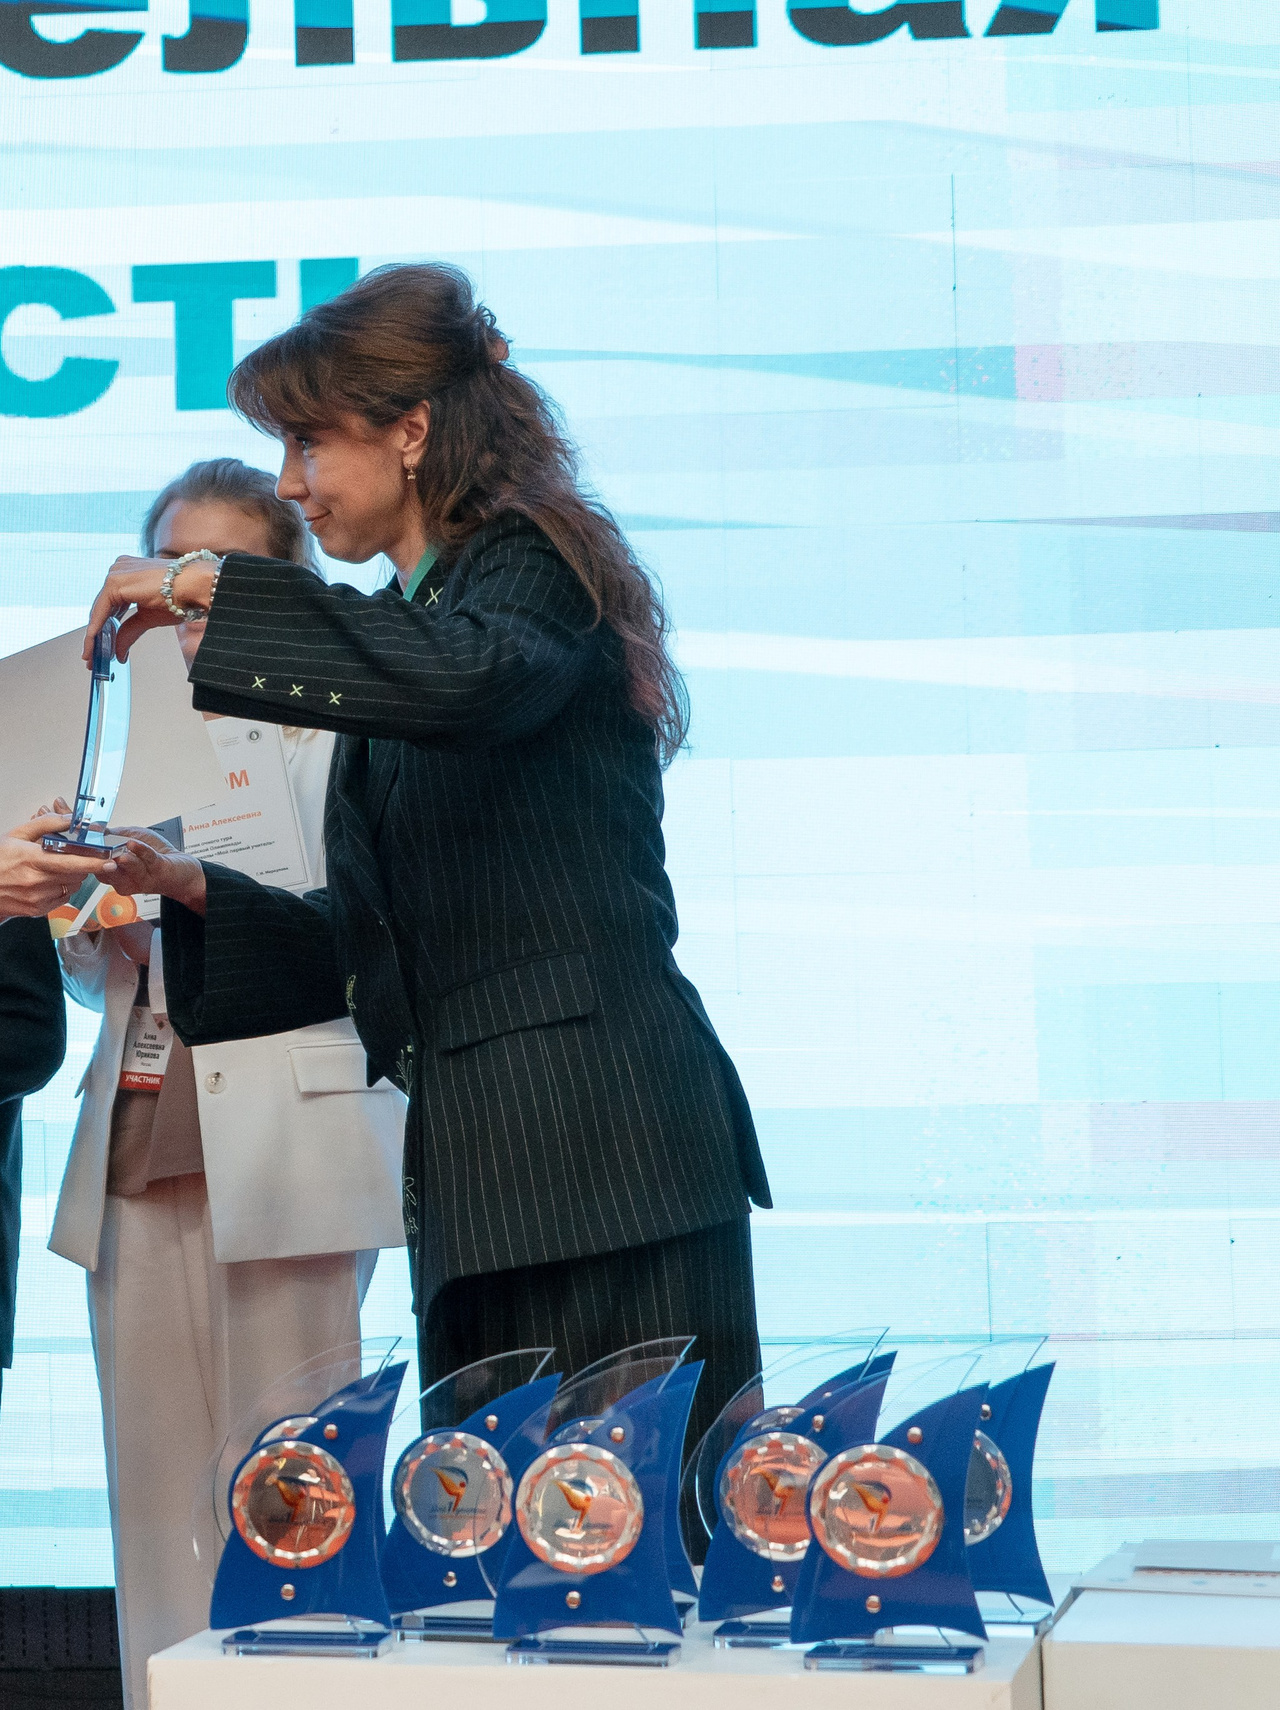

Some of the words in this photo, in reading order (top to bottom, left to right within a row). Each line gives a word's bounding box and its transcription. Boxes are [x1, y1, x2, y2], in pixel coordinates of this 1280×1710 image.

[188, 822, 210, 832] Анна
[211, 810, 262, 827] Алексеевна
[144, 1032, 157, 1040] Анна
[133, 1041, 165, 1050] Алексеевна
[125, 1074, 161, 1084] УЧАСТНИК
